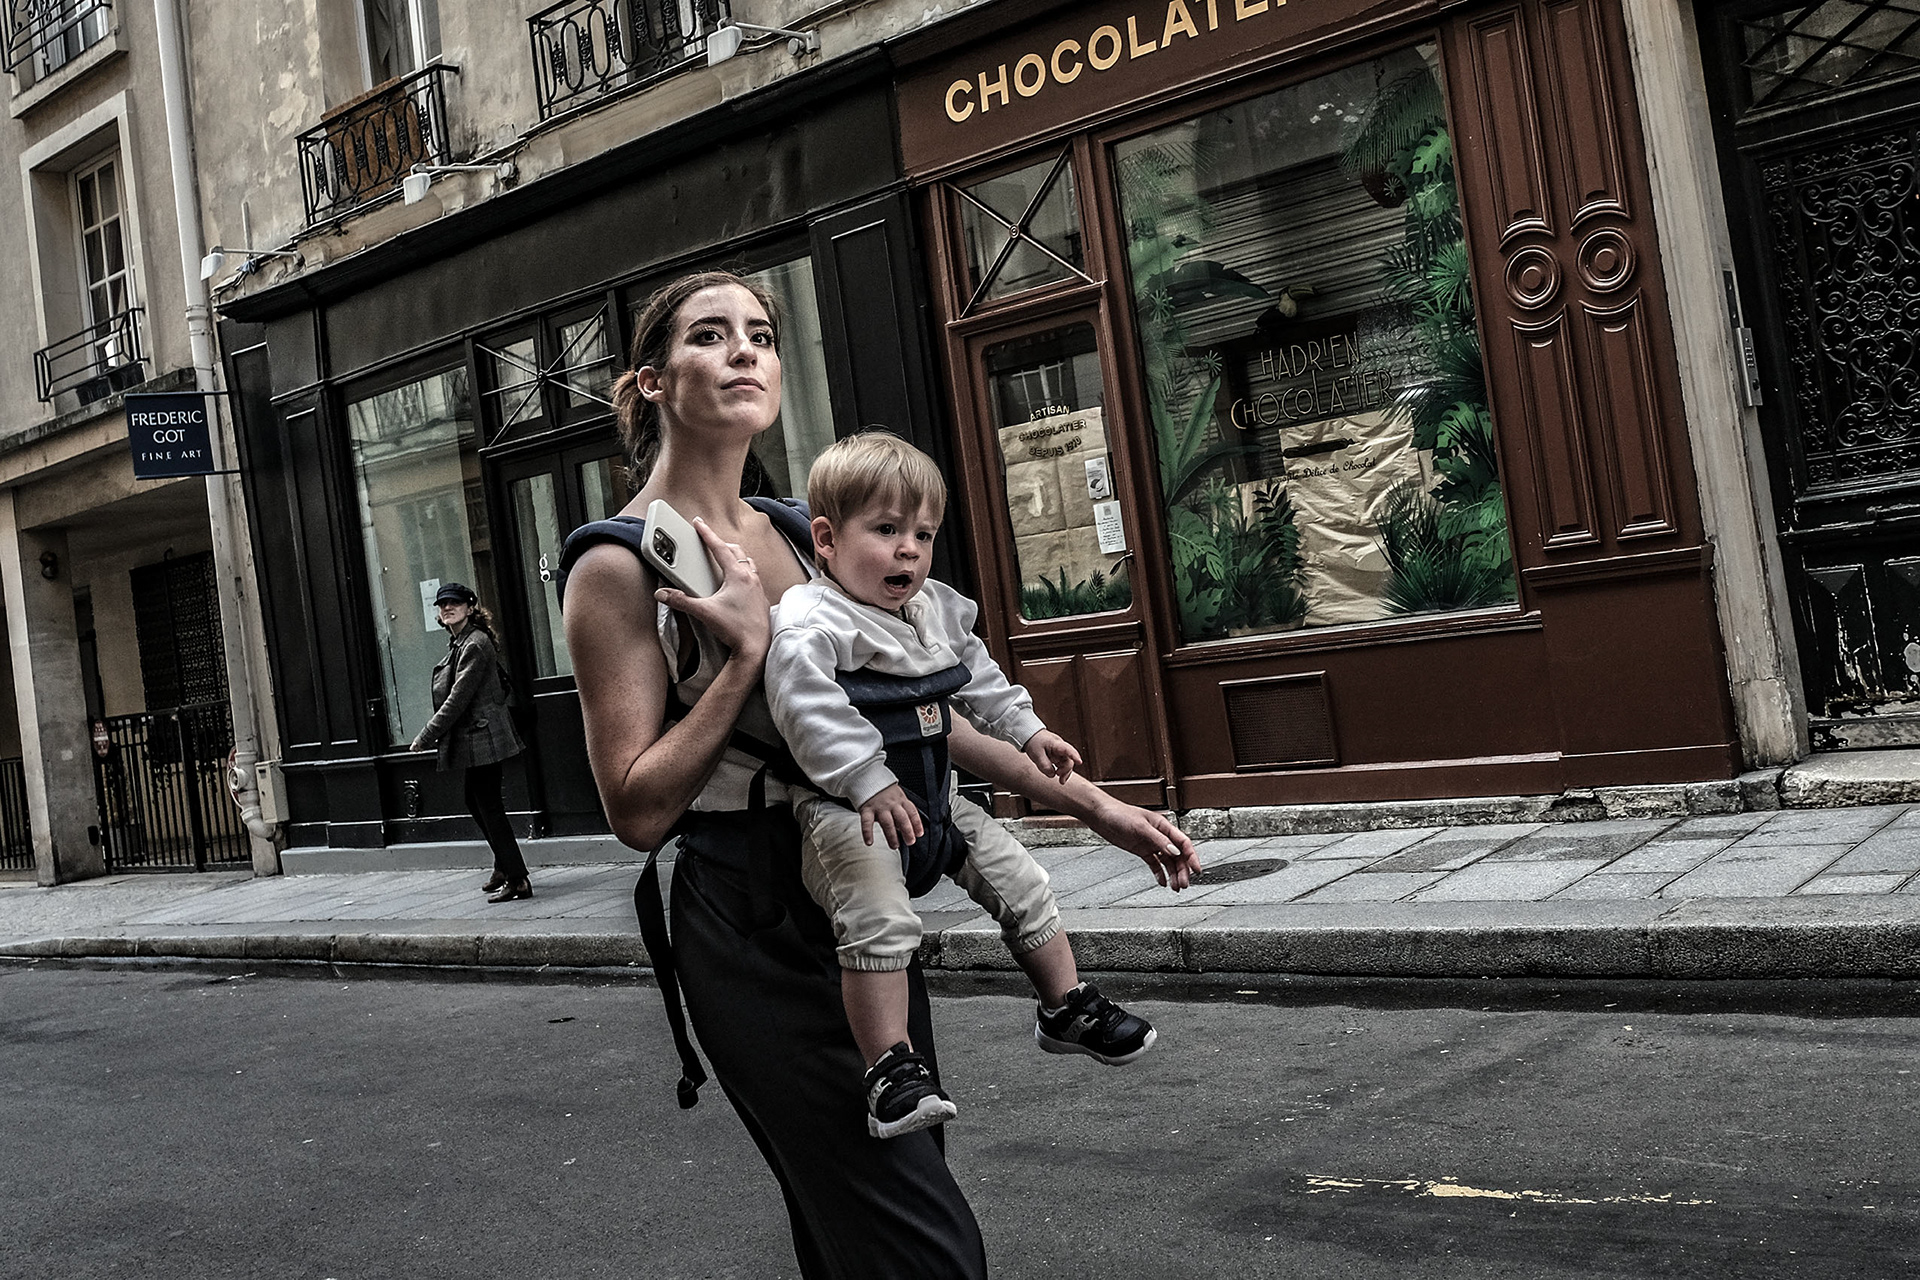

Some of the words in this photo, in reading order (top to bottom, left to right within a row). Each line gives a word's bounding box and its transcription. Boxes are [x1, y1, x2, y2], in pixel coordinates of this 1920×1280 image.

[945, 0, 1287, 122] CHOCOLAT
[1260, 331, 1361, 381] HADRIEN
[1230, 369, 1395, 430] CHOCOLATIER
[131, 410, 203, 426] FREDERIC
[1029, 405, 1070, 422] ARTISAN
[153, 429, 186, 443] GOT
[1018, 419, 1087, 442] CHOCOLATIER
[141, 451, 172, 461] FINE
[181, 449, 202, 459] ART
[1029, 445, 1064, 458] DEPUIS
[1329, 463, 1339, 474] de
[1343, 457, 1377, 472] Chocolat
